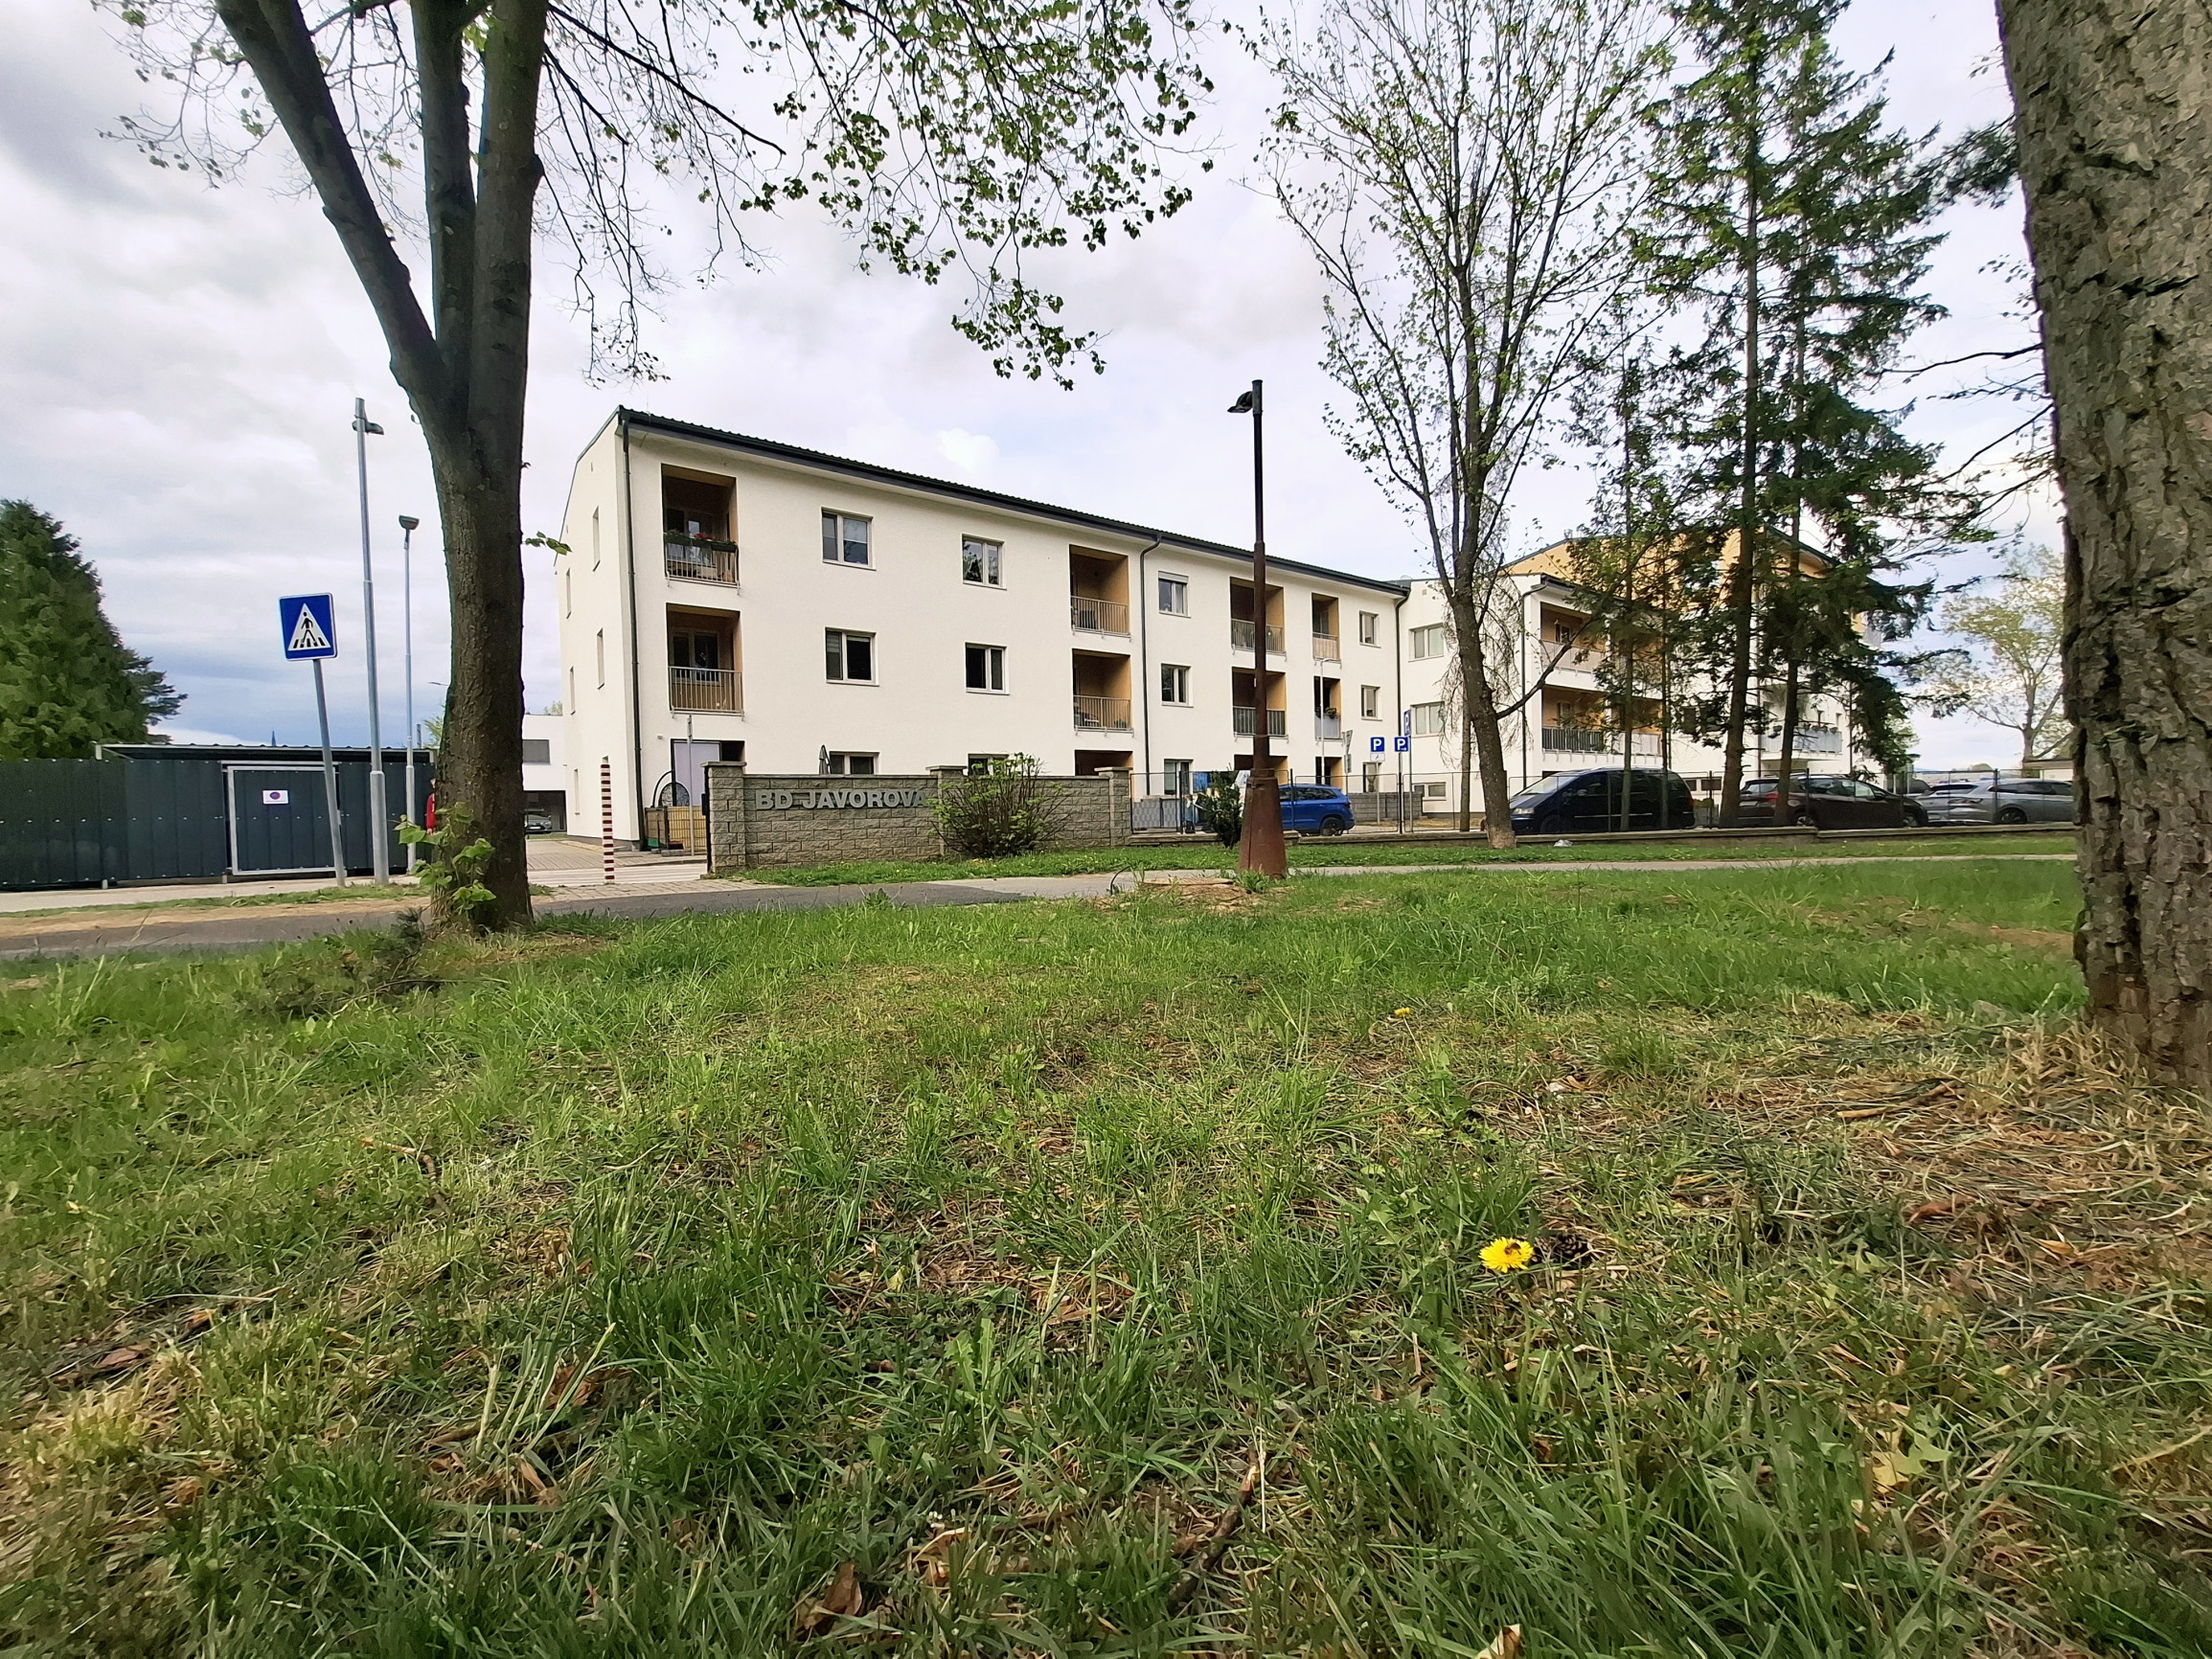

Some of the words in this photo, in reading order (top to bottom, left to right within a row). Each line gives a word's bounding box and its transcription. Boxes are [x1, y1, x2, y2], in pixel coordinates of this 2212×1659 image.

[1373, 739, 1381, 751] P
[1397, 739, 1405, 751] P
[756, 789, 793, 809] BD
